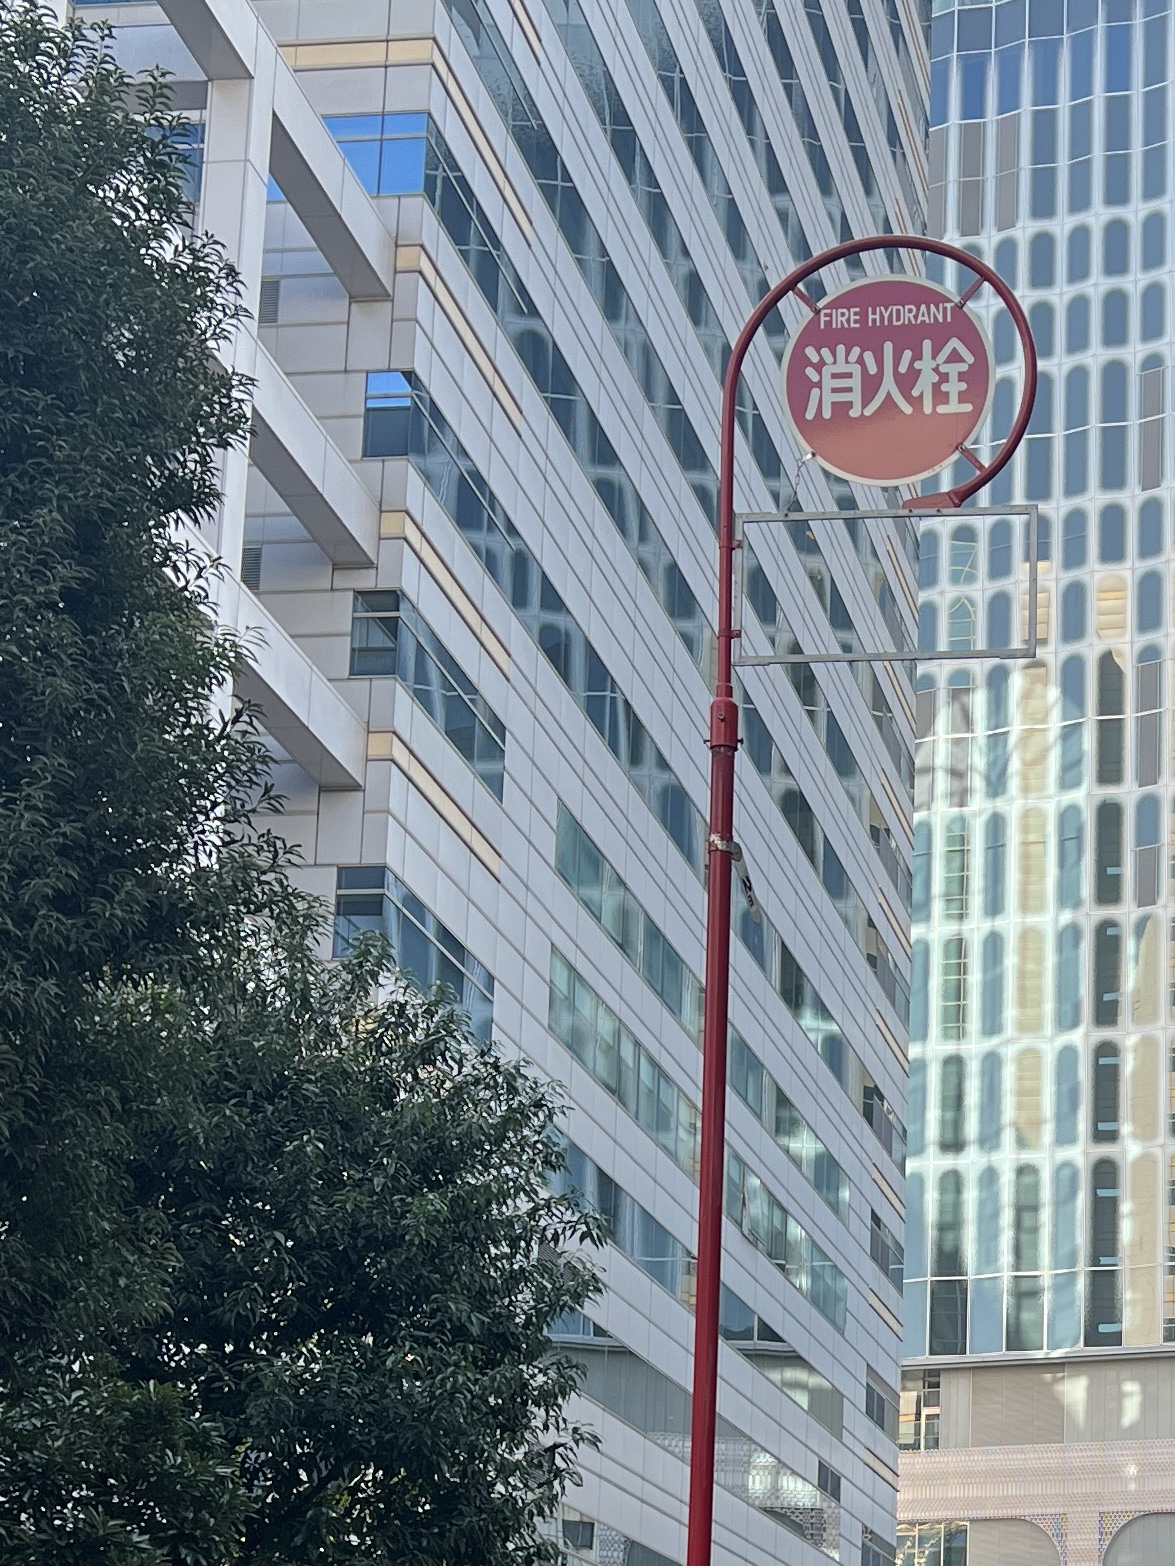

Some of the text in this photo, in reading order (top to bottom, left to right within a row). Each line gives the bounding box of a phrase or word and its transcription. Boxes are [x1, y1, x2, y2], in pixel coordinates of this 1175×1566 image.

[819, 303, 956, 329] FIRE HYDRANT
[804, 336, 975, 420] 消火栓
